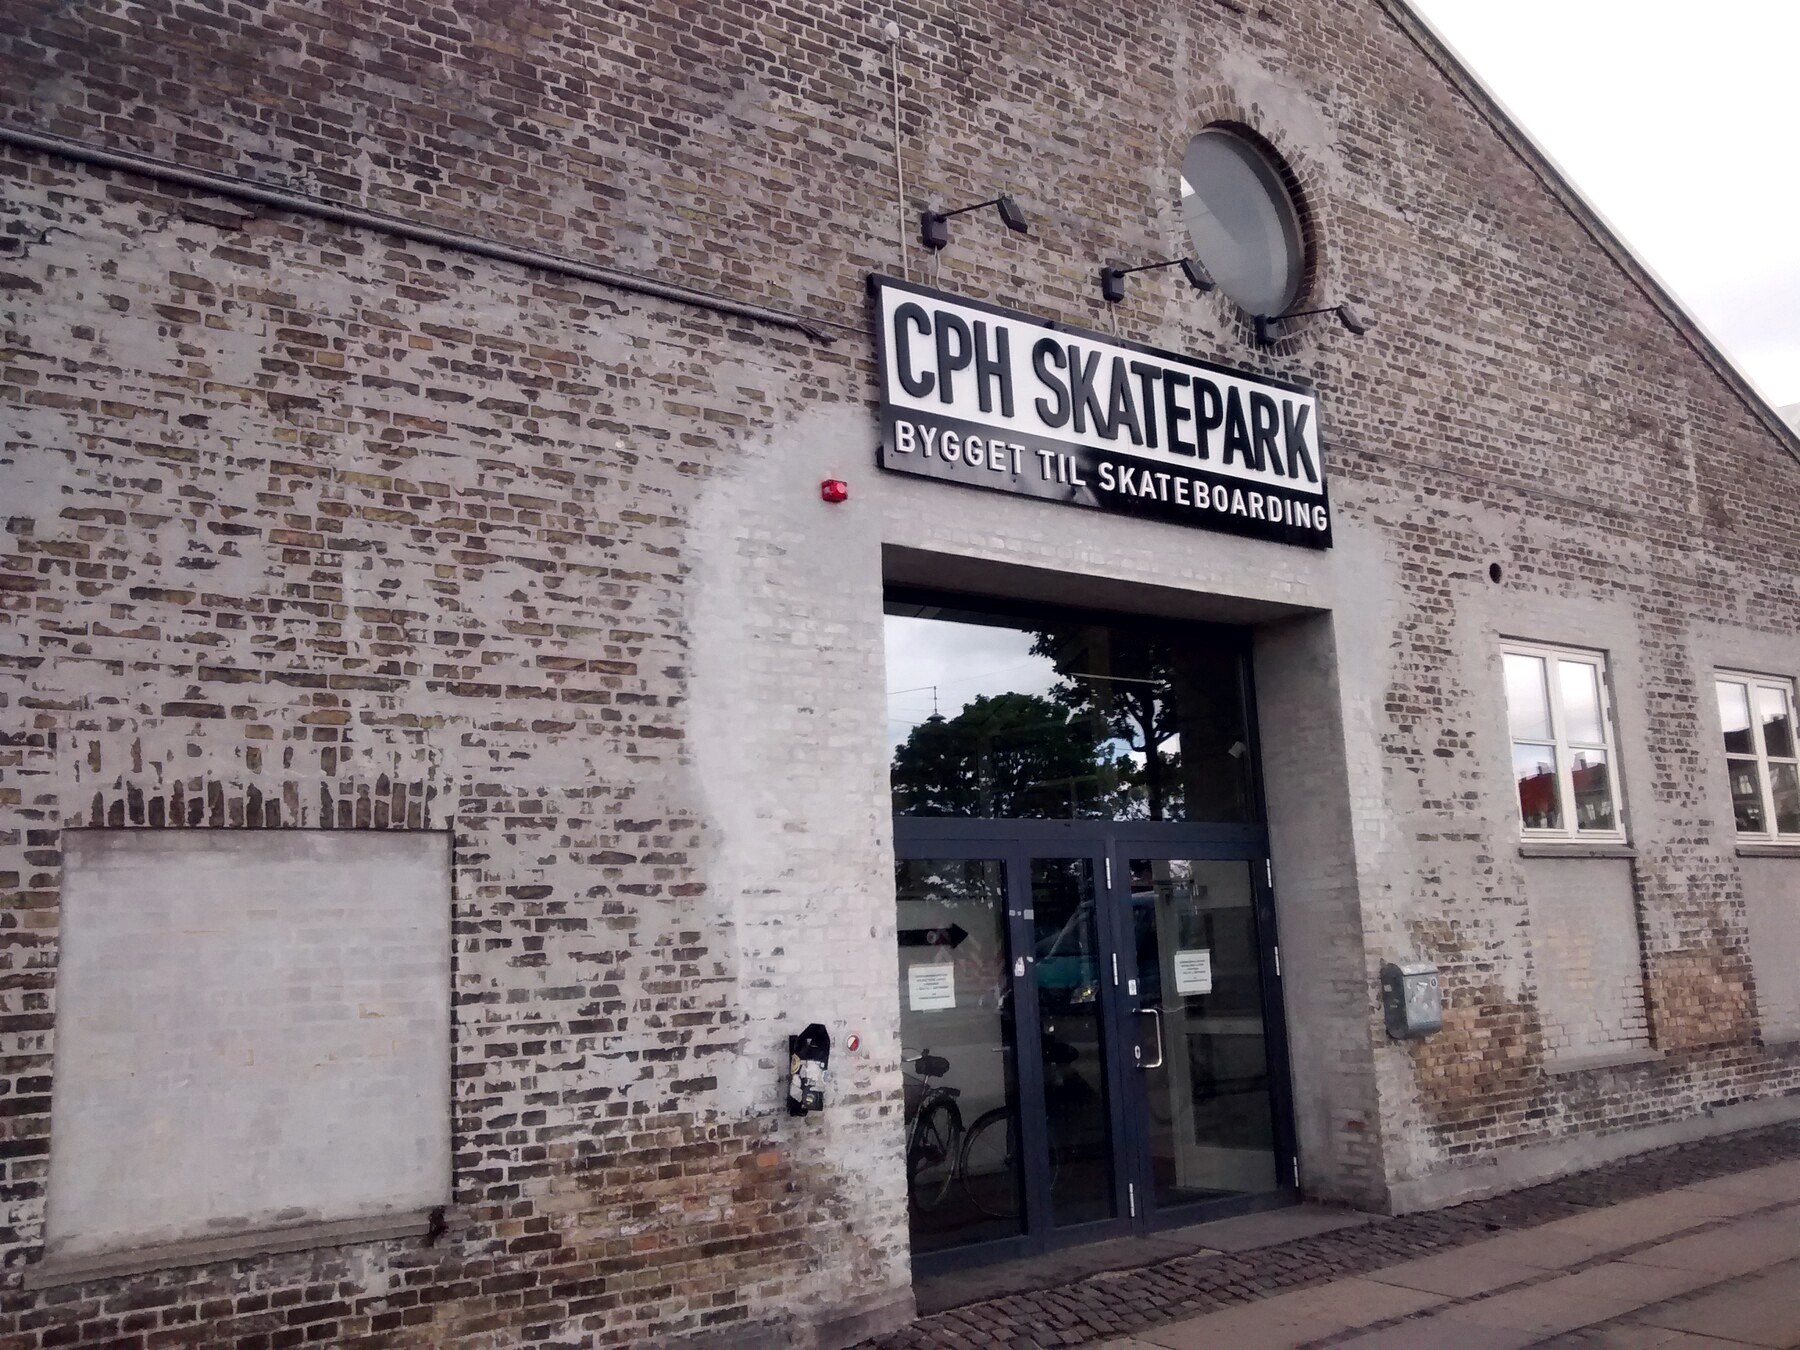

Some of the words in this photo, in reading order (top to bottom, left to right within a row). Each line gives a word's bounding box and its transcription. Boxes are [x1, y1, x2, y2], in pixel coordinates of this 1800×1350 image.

[894, 302, 1014, 417] CPH
[1033, 338, 1318, 483] SKATEPARK
[895, 420, 1025, 474] BYGGET
[1036, 450, 1087, 486] TIL
[1099, 463, 1327, 531] SKATEBOARDING
